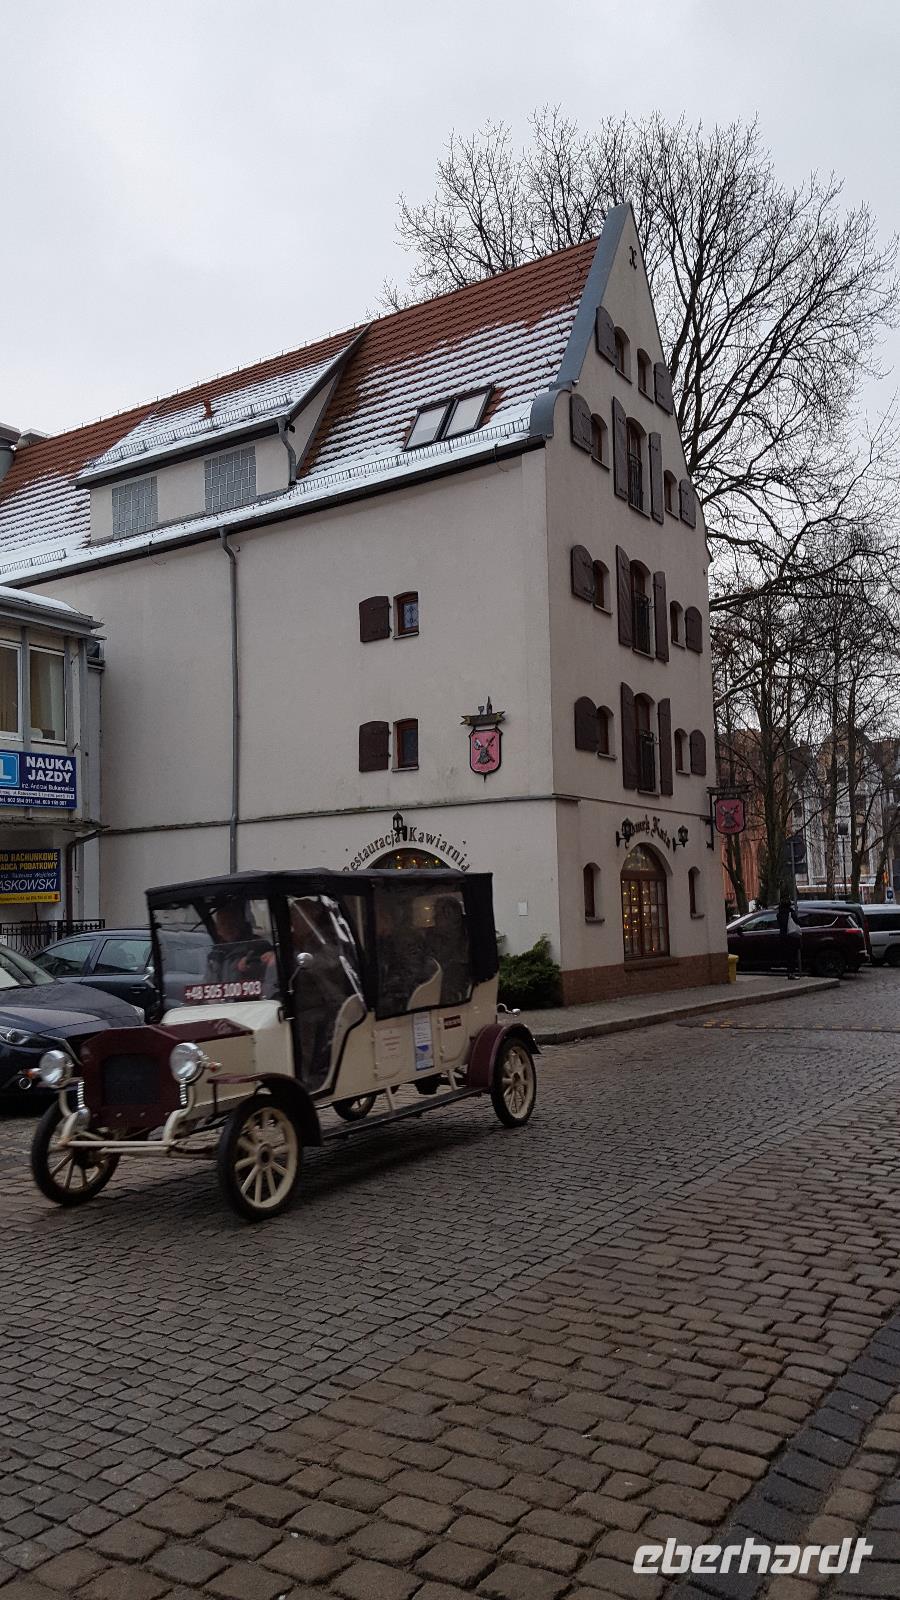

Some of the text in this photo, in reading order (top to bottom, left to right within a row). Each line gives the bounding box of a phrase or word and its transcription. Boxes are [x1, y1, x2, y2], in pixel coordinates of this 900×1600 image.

[26, 756, 74, 771] NAUKA
[28, 769, 72, 783] JAZDY
[409, 826, 471, 872] Kawiarnia
[11, 852, 58, 861] RACHUNKOWE
[20, 862, 58, 870] PODATKOWY
[0, 878, 57, 891] ASKOWSKI
[184, 985, 204, 1000] +48
[223, 982, 242, 997] 100
